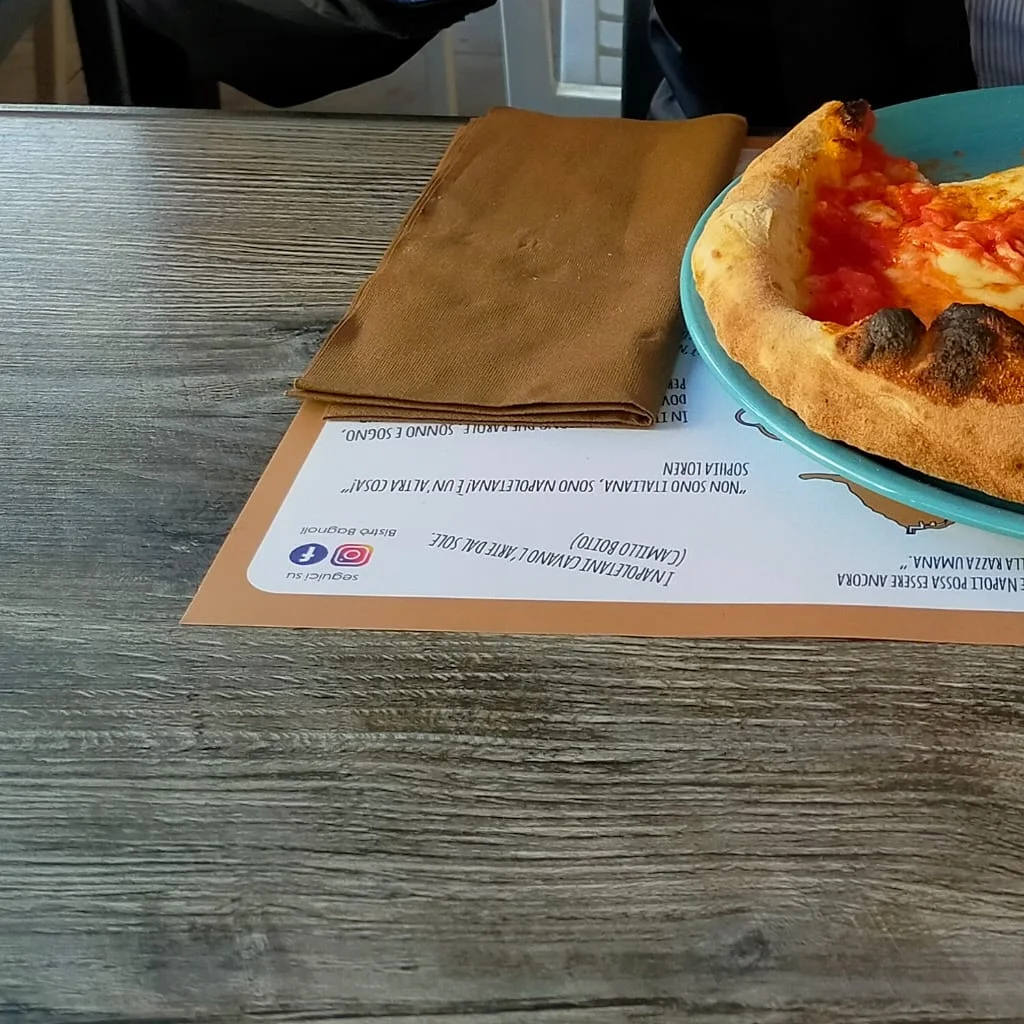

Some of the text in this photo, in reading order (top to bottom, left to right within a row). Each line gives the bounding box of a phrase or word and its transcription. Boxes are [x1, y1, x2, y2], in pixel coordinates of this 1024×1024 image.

[671, 410, 689, 424] IN
[341, 426, 393, 442] SOGNO,
[395, 427, 403, 439] E
[405, 424, 455, 438] SONNO
[663, 462, 702, 476] LOREN
[465, 479, 556, 494] NAPOLETANA!
[558, 479, 596, 493] SONO
[599, 478, 668, 494] ITALIANA,
[671, 480, 707, 494] SONO
[300, 526, 397, 537] Bistrò Bagnoli
[428, 532, 463, 551] SOLE.
[461, 538, 488, 555] DAL
[526, 549, 582, 570] CAVANO
[619, 542, 687, 567] (CAMILLO
[579, 558, 666, 584] NAPOLETANI
[966, 556, 1003, 571] RAZZA
[285, 572, 359, 582] seguici su
[837, 573, 888, 588] ANCORA
[890, 574, 929, 589] ESSERE
[931, 575, 967, 590] POSSA
